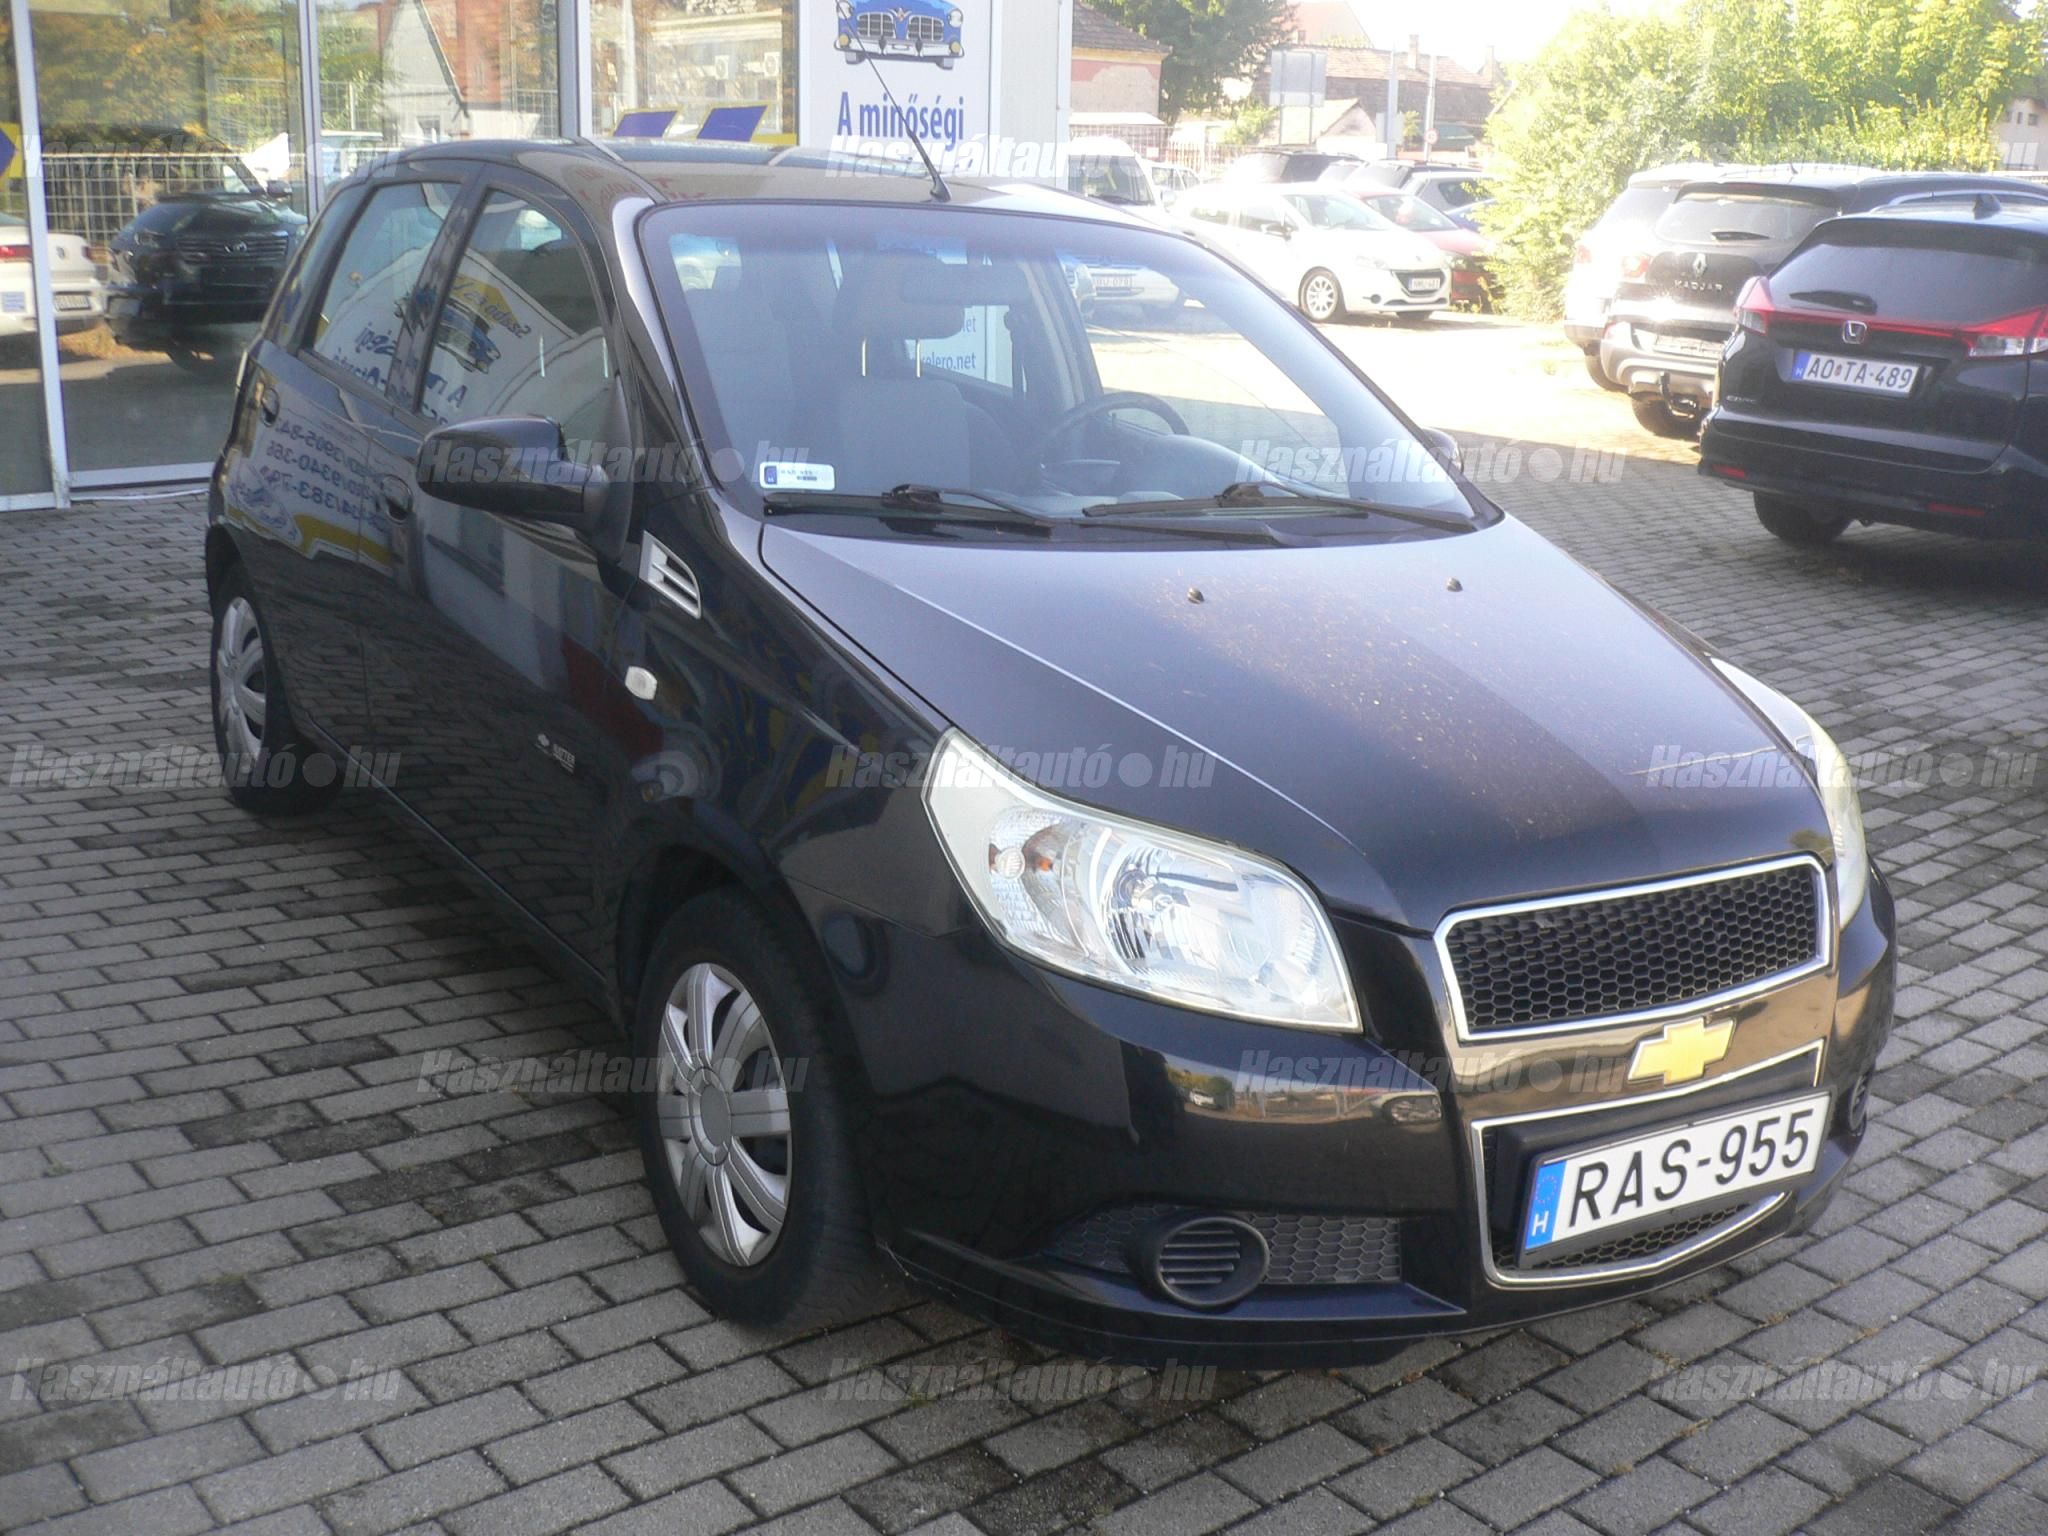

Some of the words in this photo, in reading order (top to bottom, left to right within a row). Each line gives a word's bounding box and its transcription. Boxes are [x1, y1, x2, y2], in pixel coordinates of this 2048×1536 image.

[837, 91, 853, 136] A
[859, 93, 965, 152] minőségi
[1531, 1211, 1548, 1237] H
[1568, 1108, 1815, 1229] RAS-955
